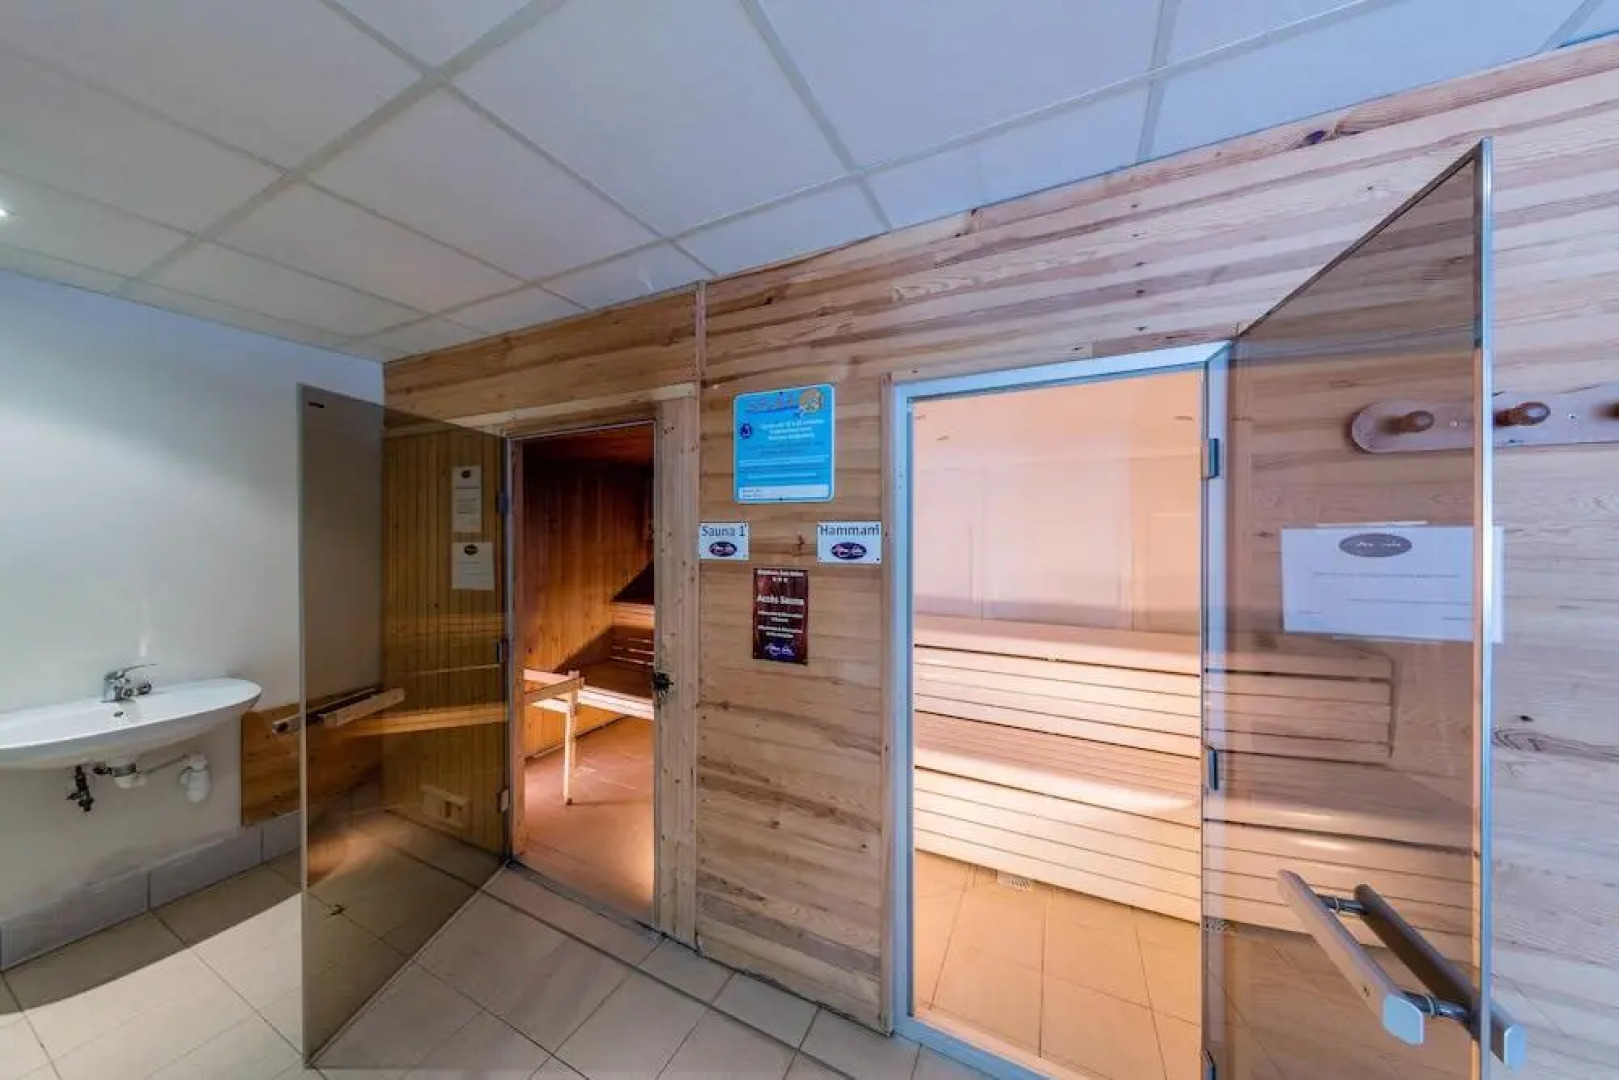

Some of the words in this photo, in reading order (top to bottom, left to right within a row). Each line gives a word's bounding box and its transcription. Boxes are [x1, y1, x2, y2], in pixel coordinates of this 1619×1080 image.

[701, 525, 736, 536] Sauna
[739, 525, 746, 536] 1
[820, 524, 880, 536] Hammam
